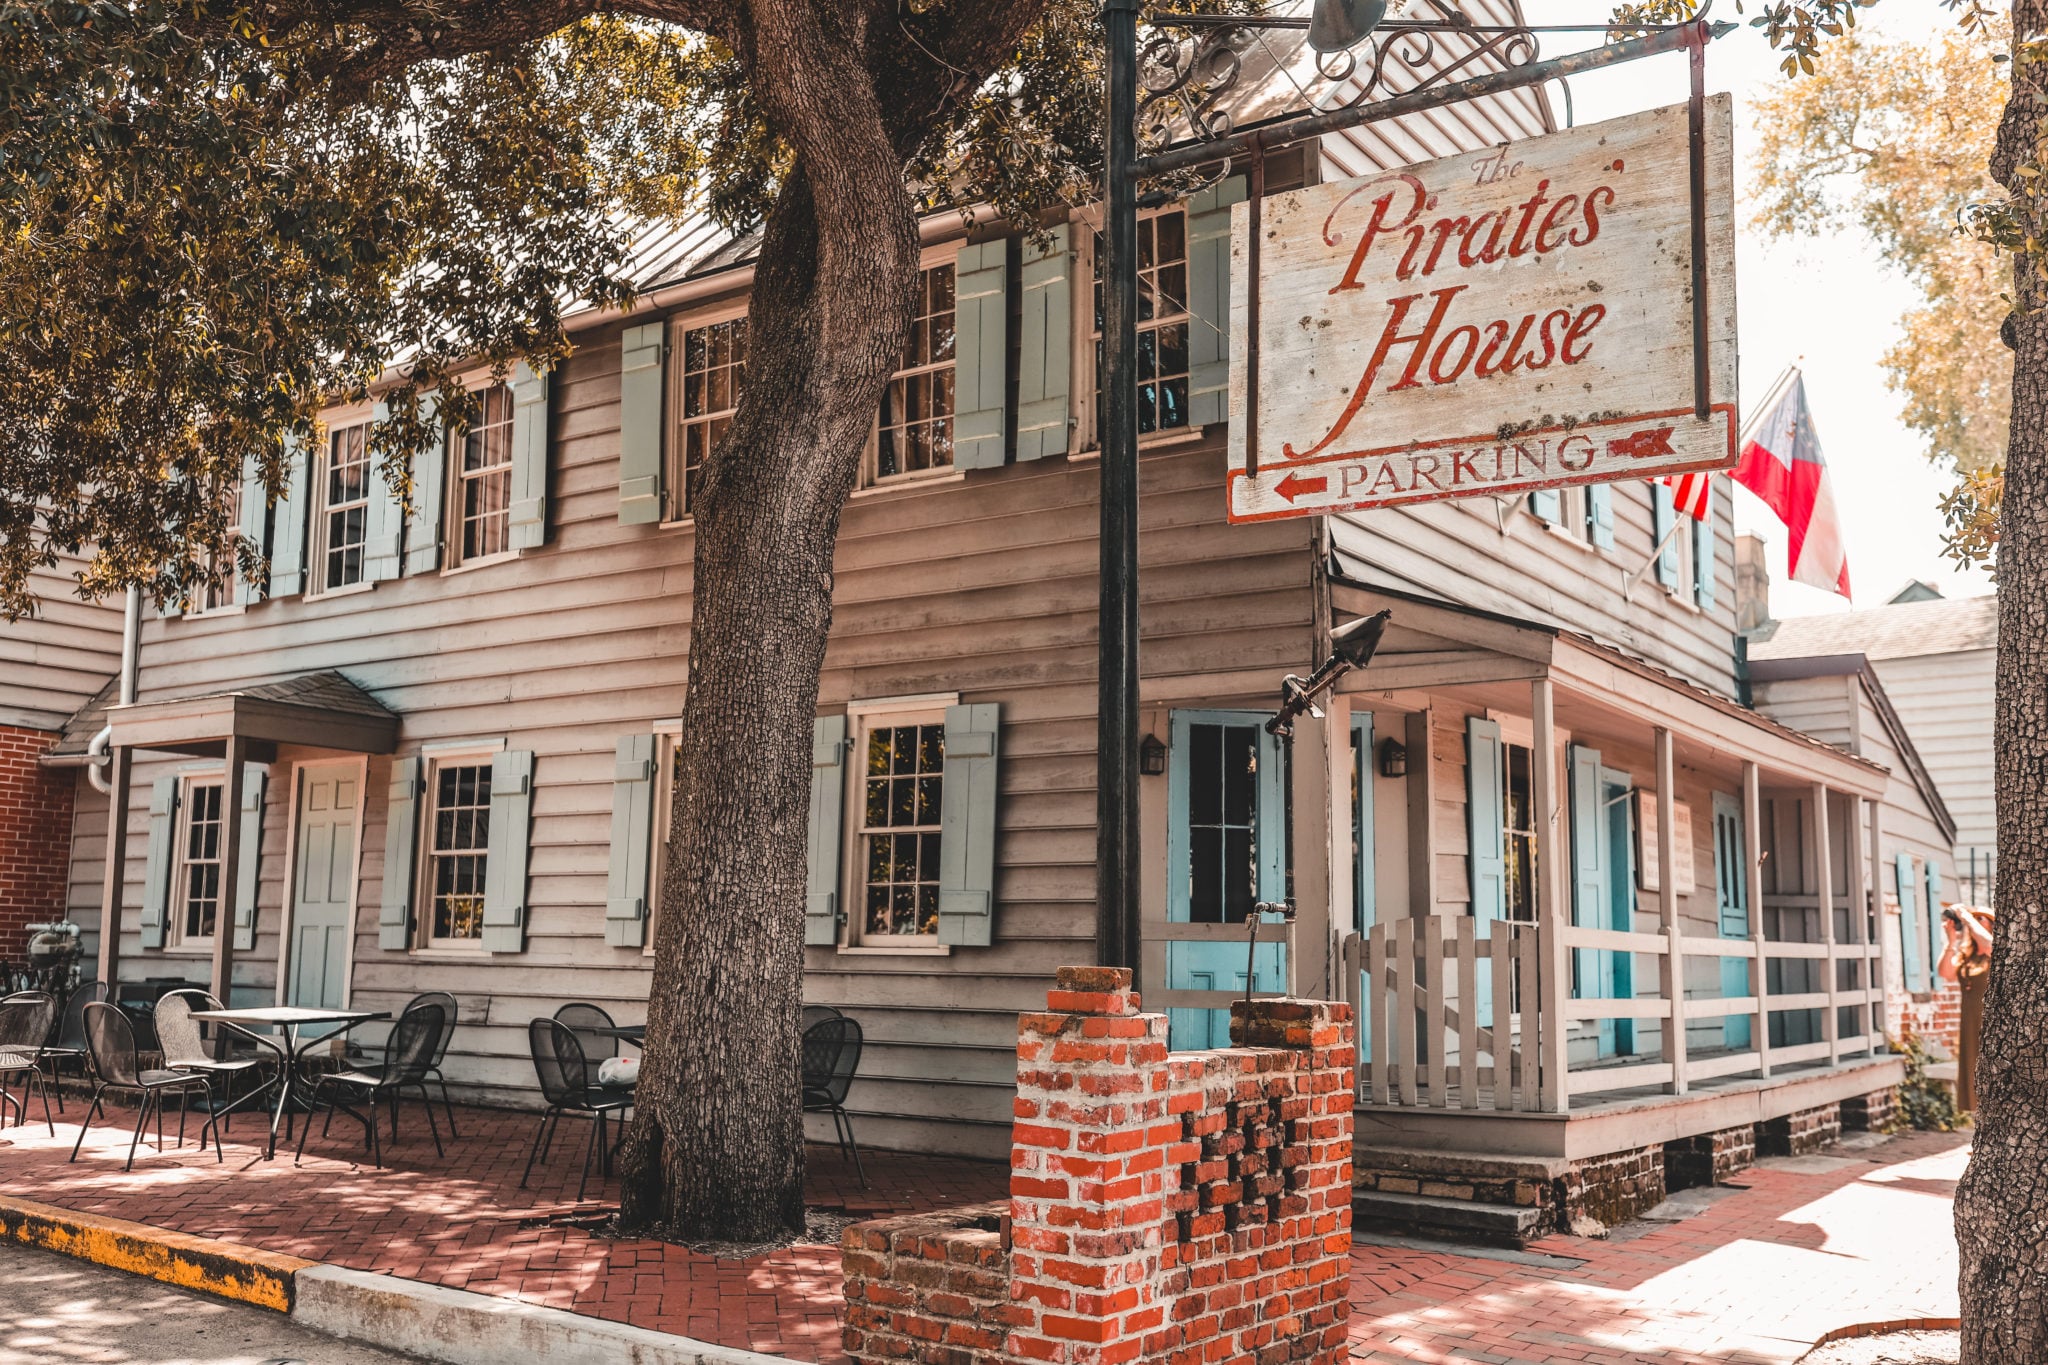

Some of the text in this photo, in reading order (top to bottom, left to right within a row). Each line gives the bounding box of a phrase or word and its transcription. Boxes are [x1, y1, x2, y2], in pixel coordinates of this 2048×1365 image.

[1471, 147, 1523, 186] The
[1283, 285, 1606, 460] House
[1338, 434, 1600, 499] PARKING
